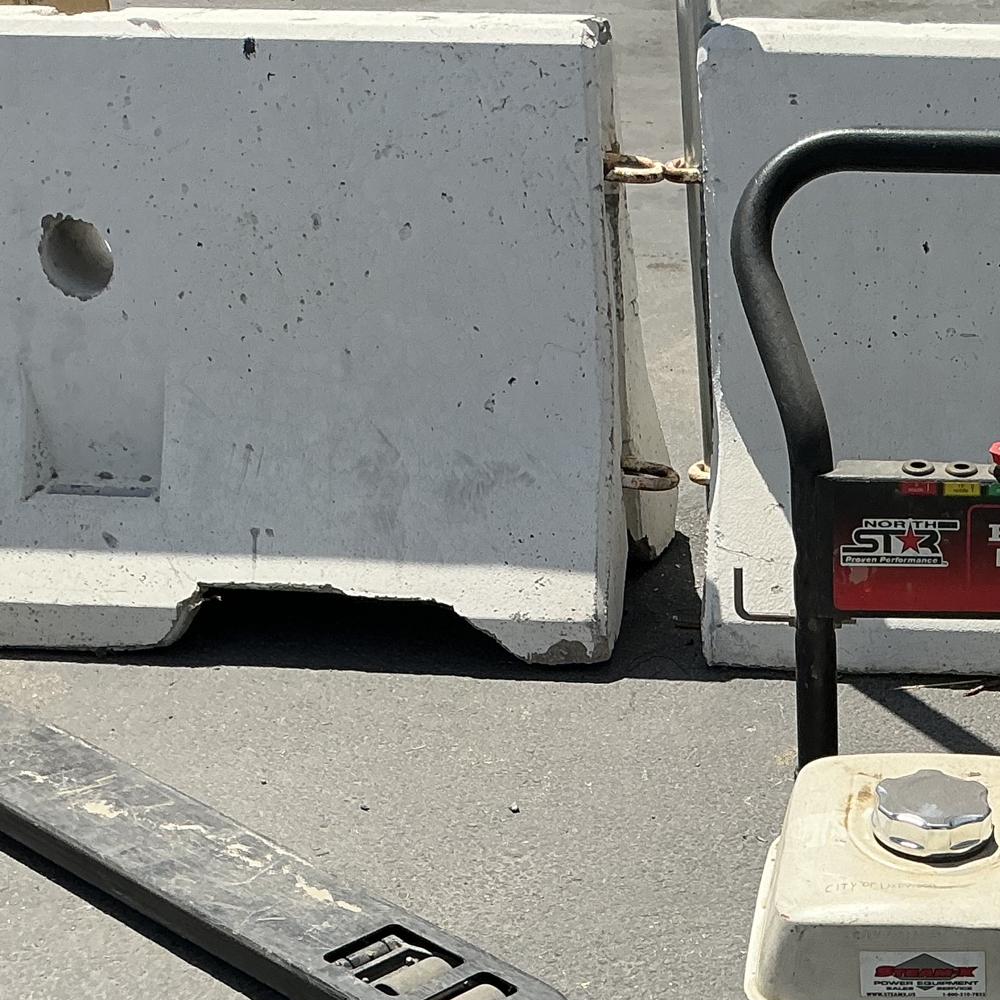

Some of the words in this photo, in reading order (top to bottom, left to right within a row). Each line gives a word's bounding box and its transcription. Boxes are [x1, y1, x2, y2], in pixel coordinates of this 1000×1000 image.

[864, 520, 937, 528] NORTH
[845, 556, 877, 564] Proven
[879, 556, 938, 564] Performance
[825, 881, 857, 893] CITY
